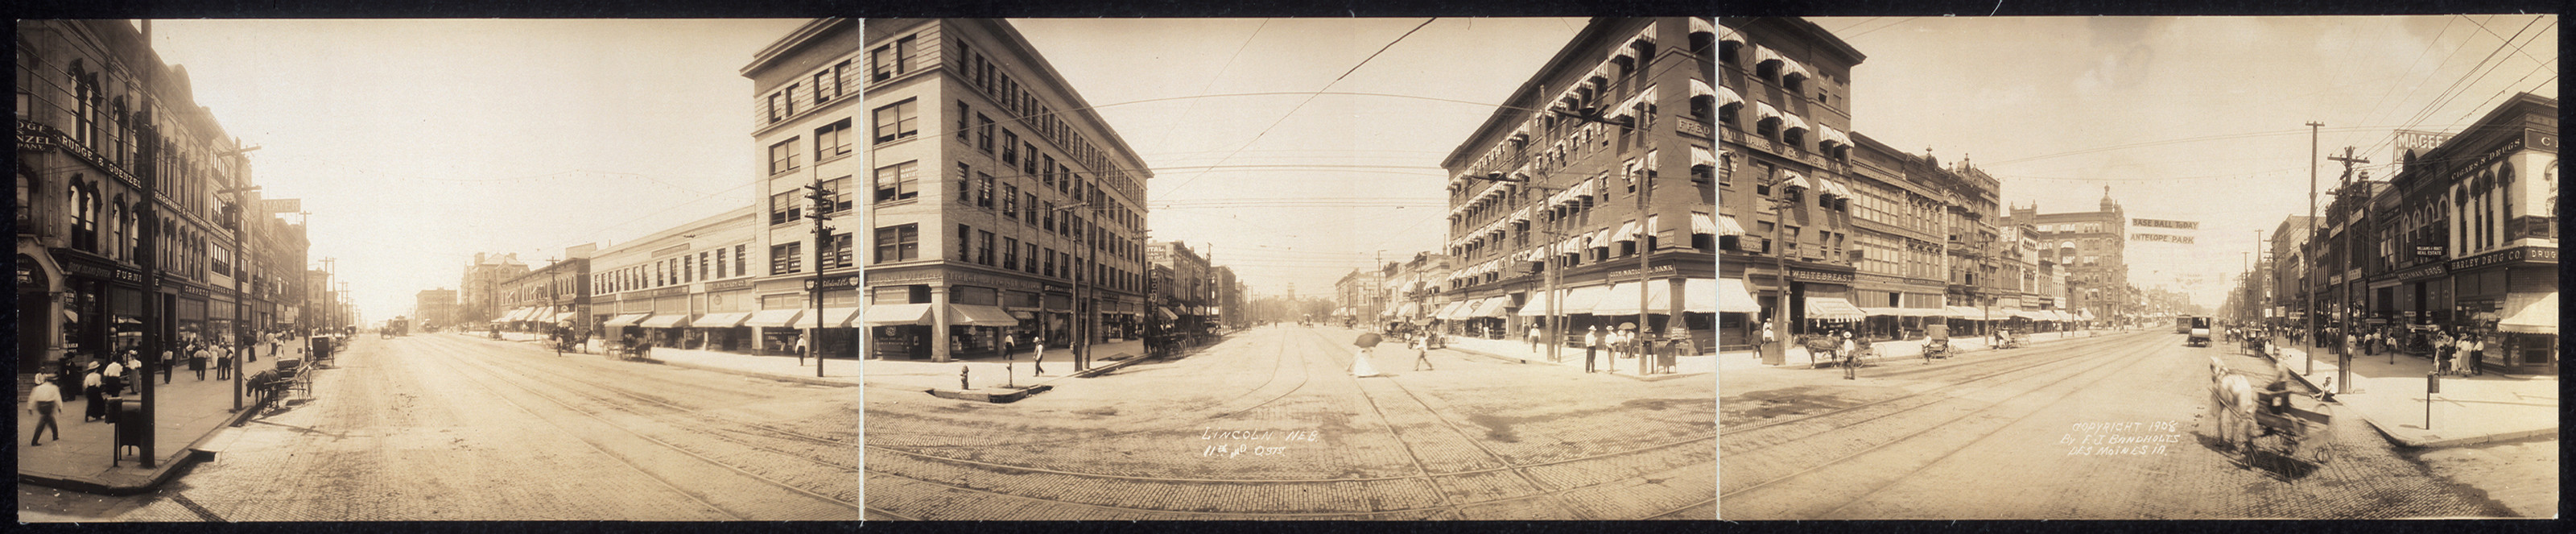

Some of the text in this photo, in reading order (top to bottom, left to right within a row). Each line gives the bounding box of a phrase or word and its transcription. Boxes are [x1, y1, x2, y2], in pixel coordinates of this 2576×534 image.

[1678, 119, 1710, 135] FRED
[1720, 126, 1771, 151] WILLIAMS
[1804, 155, 1852, 175] INSURANCE
[2397, 132, 2443, 149] MAGEE
[63, 135, 142, 188] RUDGE & GUENZEL
[2451, 139, 2520, 180] CIGARS & DRUGS
[155, 191, 181, 212] HARDWARE
[262, 201, 299, 210] MAYER
[2132, 218, 2152, 226] BASE
[2154, 220, 2173, 228] BALL
[2130, 234, 2194, 244] ANTELOPE PARK
[1655, 264, 1673, 272] BANK
[2452, 258, 2479, 270] HARLEY
[2482, 253, 2504, 265] DRUG
[116, 269, 159, 286] FURNIE
[949, 272, 976, 282] Ticket
[1792, 270, 1852, 282] WHITEBREAST
[2425, 266, 2442, 275] BROS
